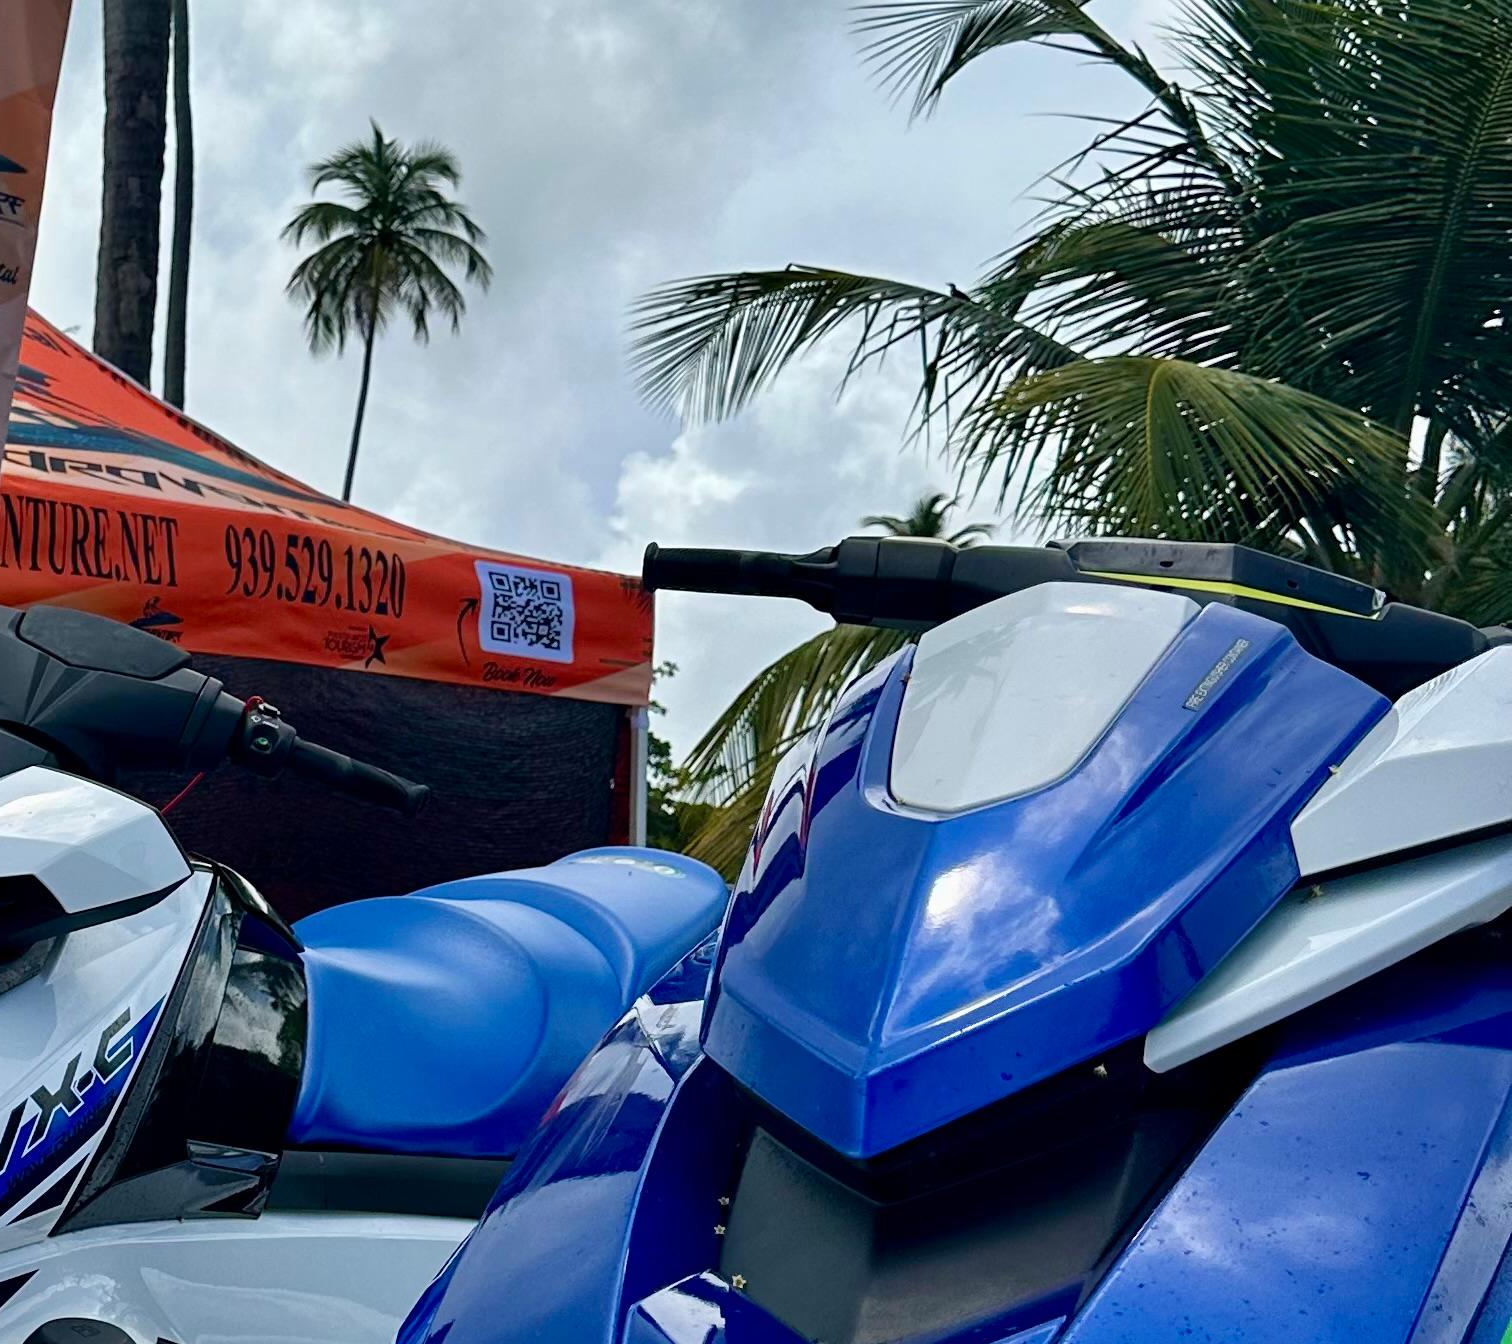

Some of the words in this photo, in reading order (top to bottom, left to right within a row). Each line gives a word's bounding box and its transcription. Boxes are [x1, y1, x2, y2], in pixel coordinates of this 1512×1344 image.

[224, 524, 406, 619] 939.529.1320
[482, 661, 520, 683] Book
[523, 666, 558, 689] Now
